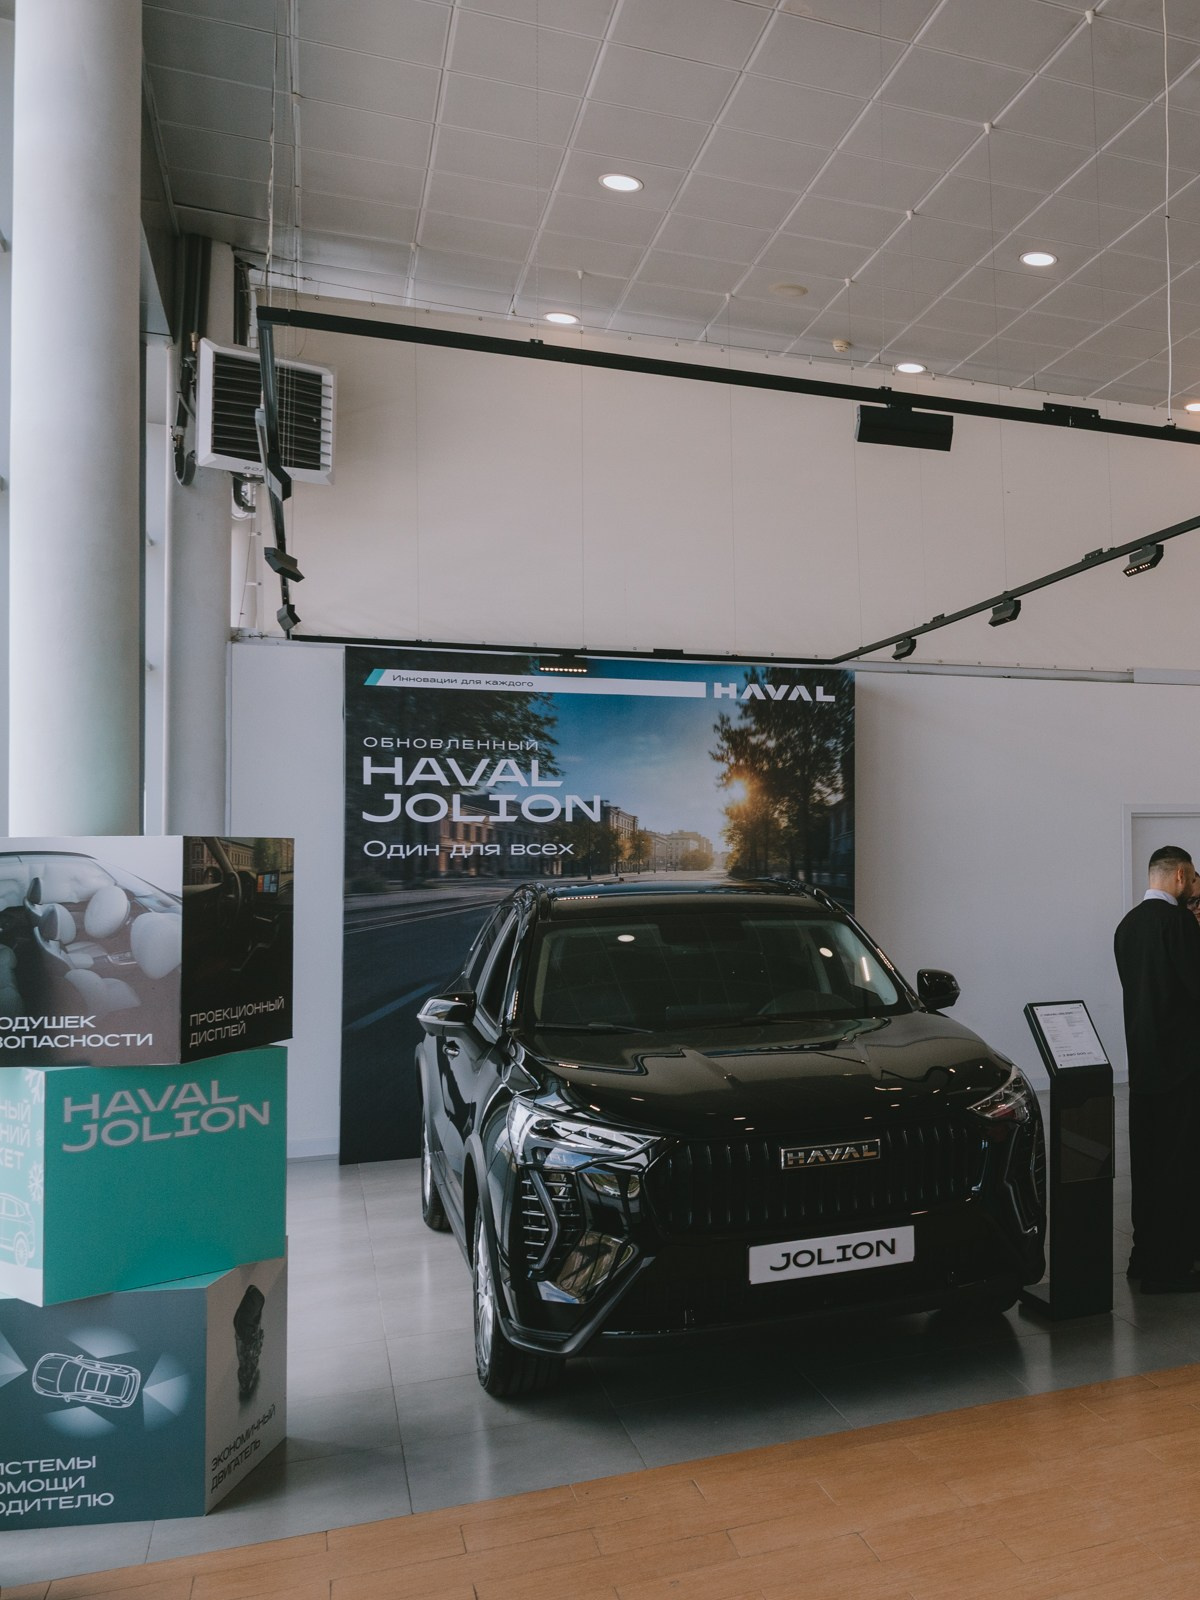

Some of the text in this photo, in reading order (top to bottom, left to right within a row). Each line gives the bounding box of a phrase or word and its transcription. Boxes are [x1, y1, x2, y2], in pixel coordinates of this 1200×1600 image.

[392, 674, 534, 688] Инновации для каждого
[713, 682, 836, 702] HAVAL
[362, 736, 538, 751] ОБНОВЛЕННЫЙ
[362, 756, 564, 788] HAVAL
[362, 792, 601, 823] JOLION
[363, 840, 575, 859] Один для всех
[189, 995, 285, 1027] ПРОЕКЦИОННЫЙ
[0, 1033, 154, 1049] ОПАСНОСТИ
[189, 1020, 246, 1049] ДИСПЛЕЙ
[62, 1079, 240, 1124] HAVAL
[61, 1100, 271, 1153] JOLION
[786, 1144, 878, 1166] HAVAL
[769, 1237, 896, 1273] JOLION
[0, 1455, 97, 1476] СТЕМЫ
